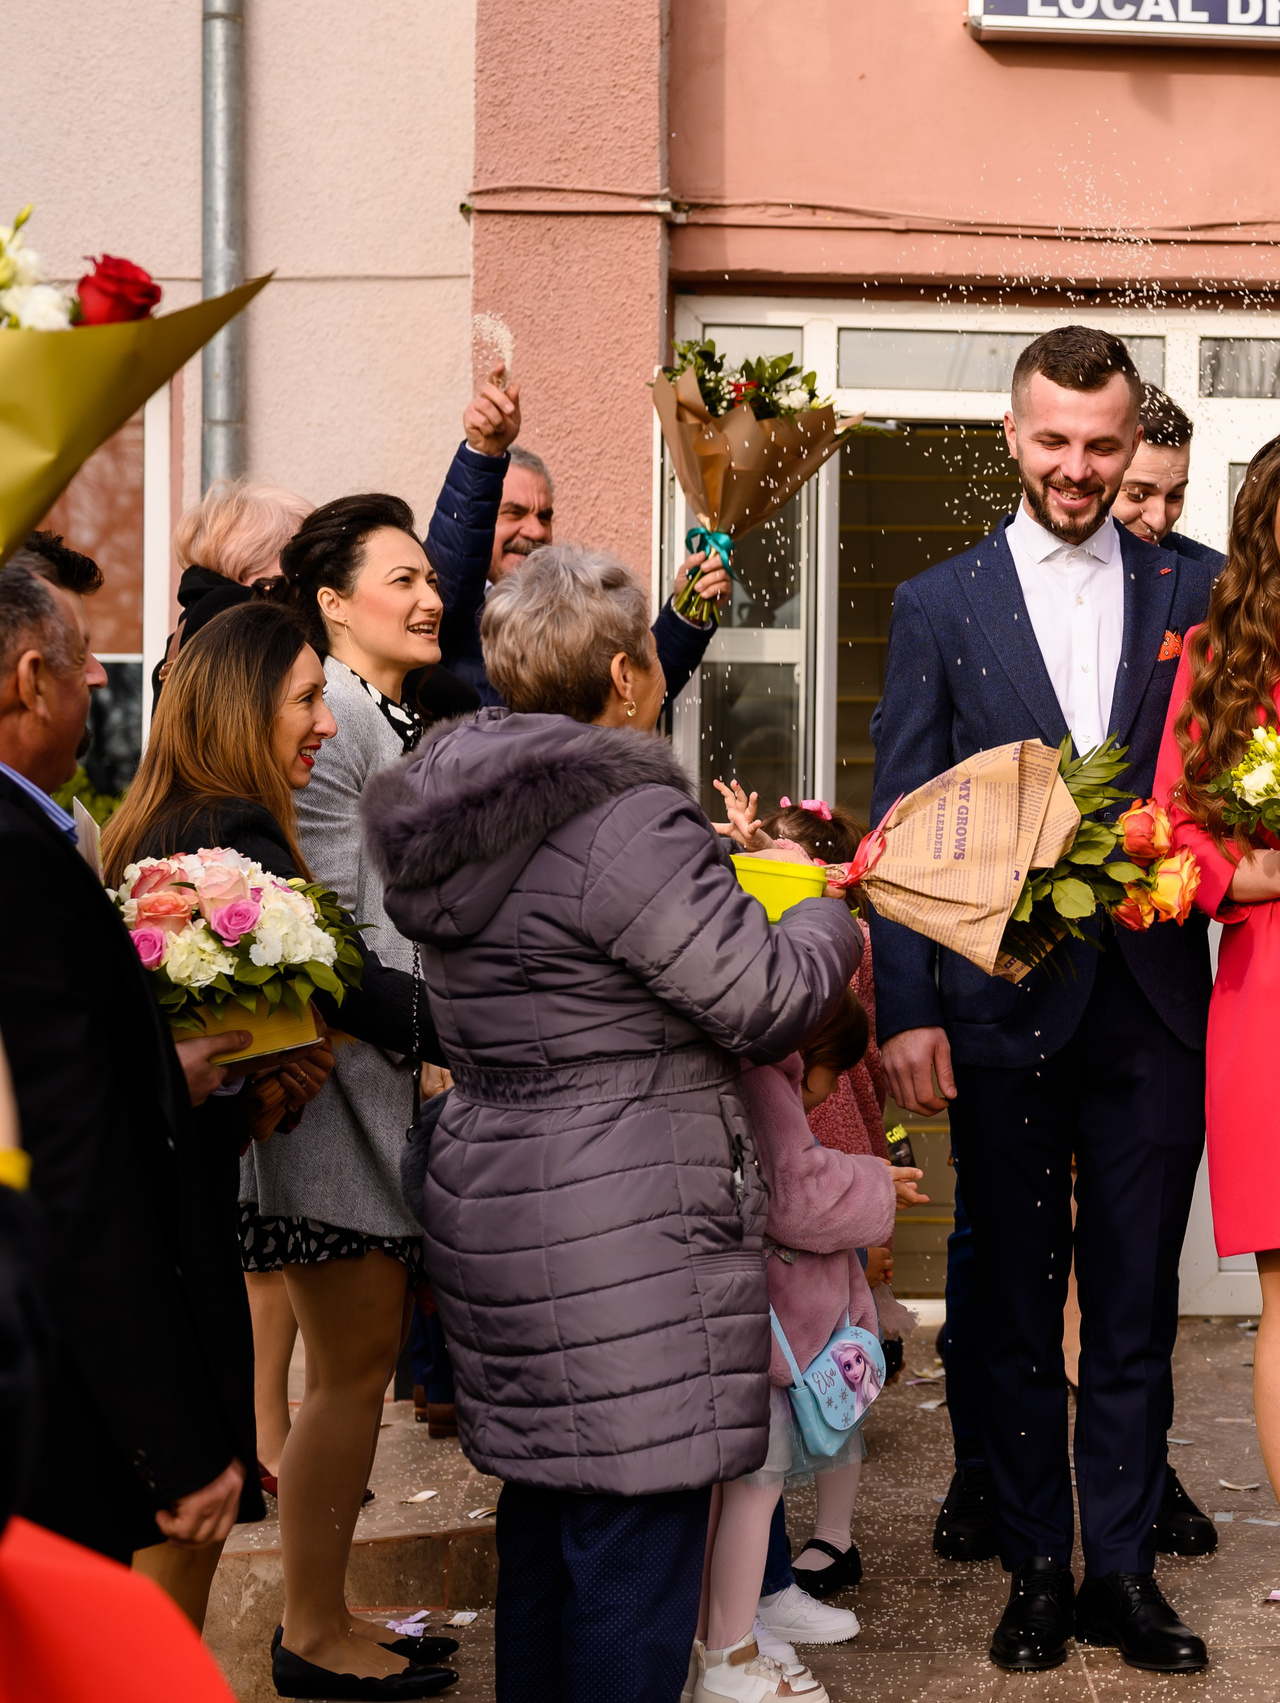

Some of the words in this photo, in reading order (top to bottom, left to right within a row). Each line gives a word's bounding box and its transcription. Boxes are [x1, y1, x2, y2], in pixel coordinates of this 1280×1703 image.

[933, 813, 945, 859] LEADERS
[953, 805, 970, 860] GROWS
[811, 1368, 837, 1395] Elsa
